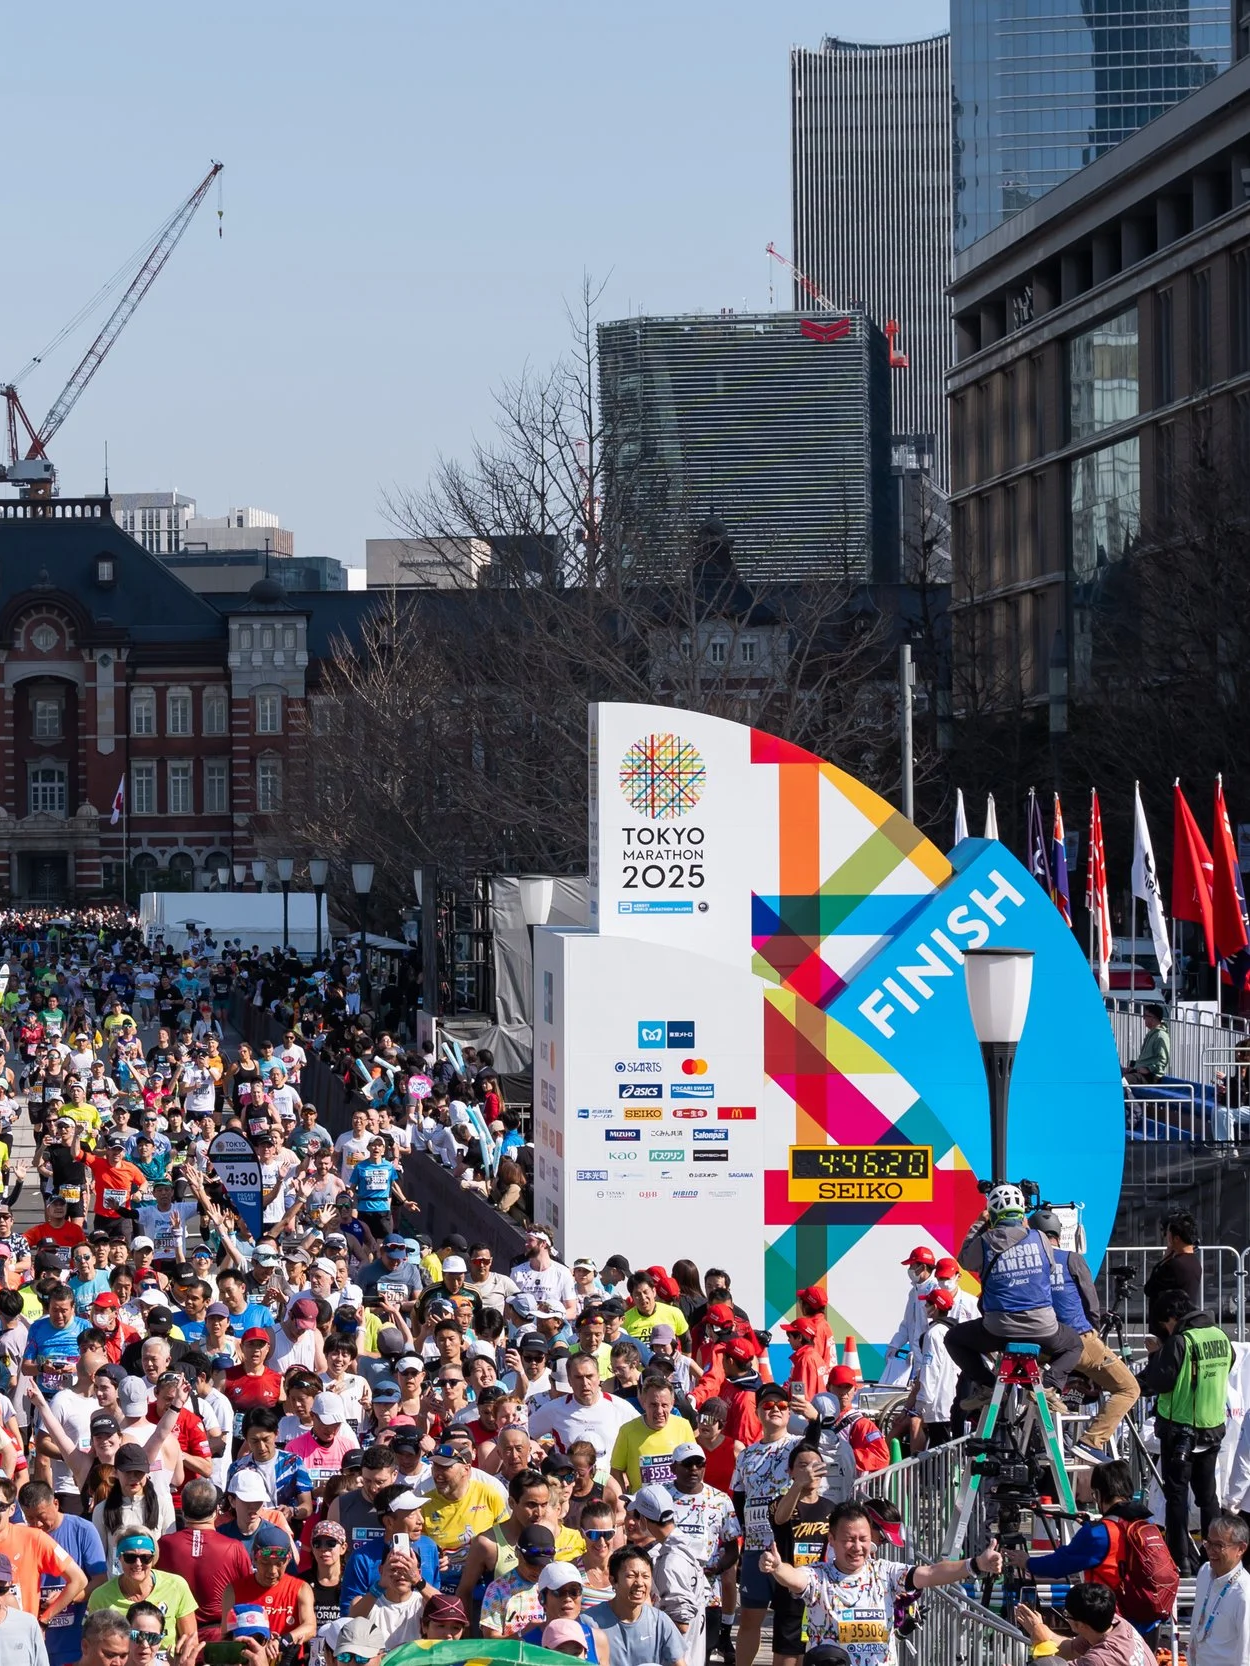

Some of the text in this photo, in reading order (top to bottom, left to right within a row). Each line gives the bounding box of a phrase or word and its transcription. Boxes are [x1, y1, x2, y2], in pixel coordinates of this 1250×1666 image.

[622, 827, 705, 845] TOKYO
[623, 850, 703, 860] MARATHON
[622, 864, 705, 888] 2025
[857, 869, 1026, 1039] FINISH
[625, 1110, 662, 1118] SEIKO
[693, 1131, 726, 1140] Salonpas
[651, 1151, 683, 1160] バスクリン
[818, 1152, 924, 1176] 4:46:20
[226, 1172, 258, 1186] 4:30
[577, 1171, 608, 1180] 日本光電
[819, 1182, 903, 1199] SEIKO
[990, 1244, 1040, 1262] SONSOR
[1202, 1339, 1229, 1360] CAMERA
[650, 1465, 672, 1479] 3553
[793, 1522, 830, 1538] TAIPE
[855, 1611, 886, 1620] 東京メトロ
[850, 1623, 885, 1640] 35308
